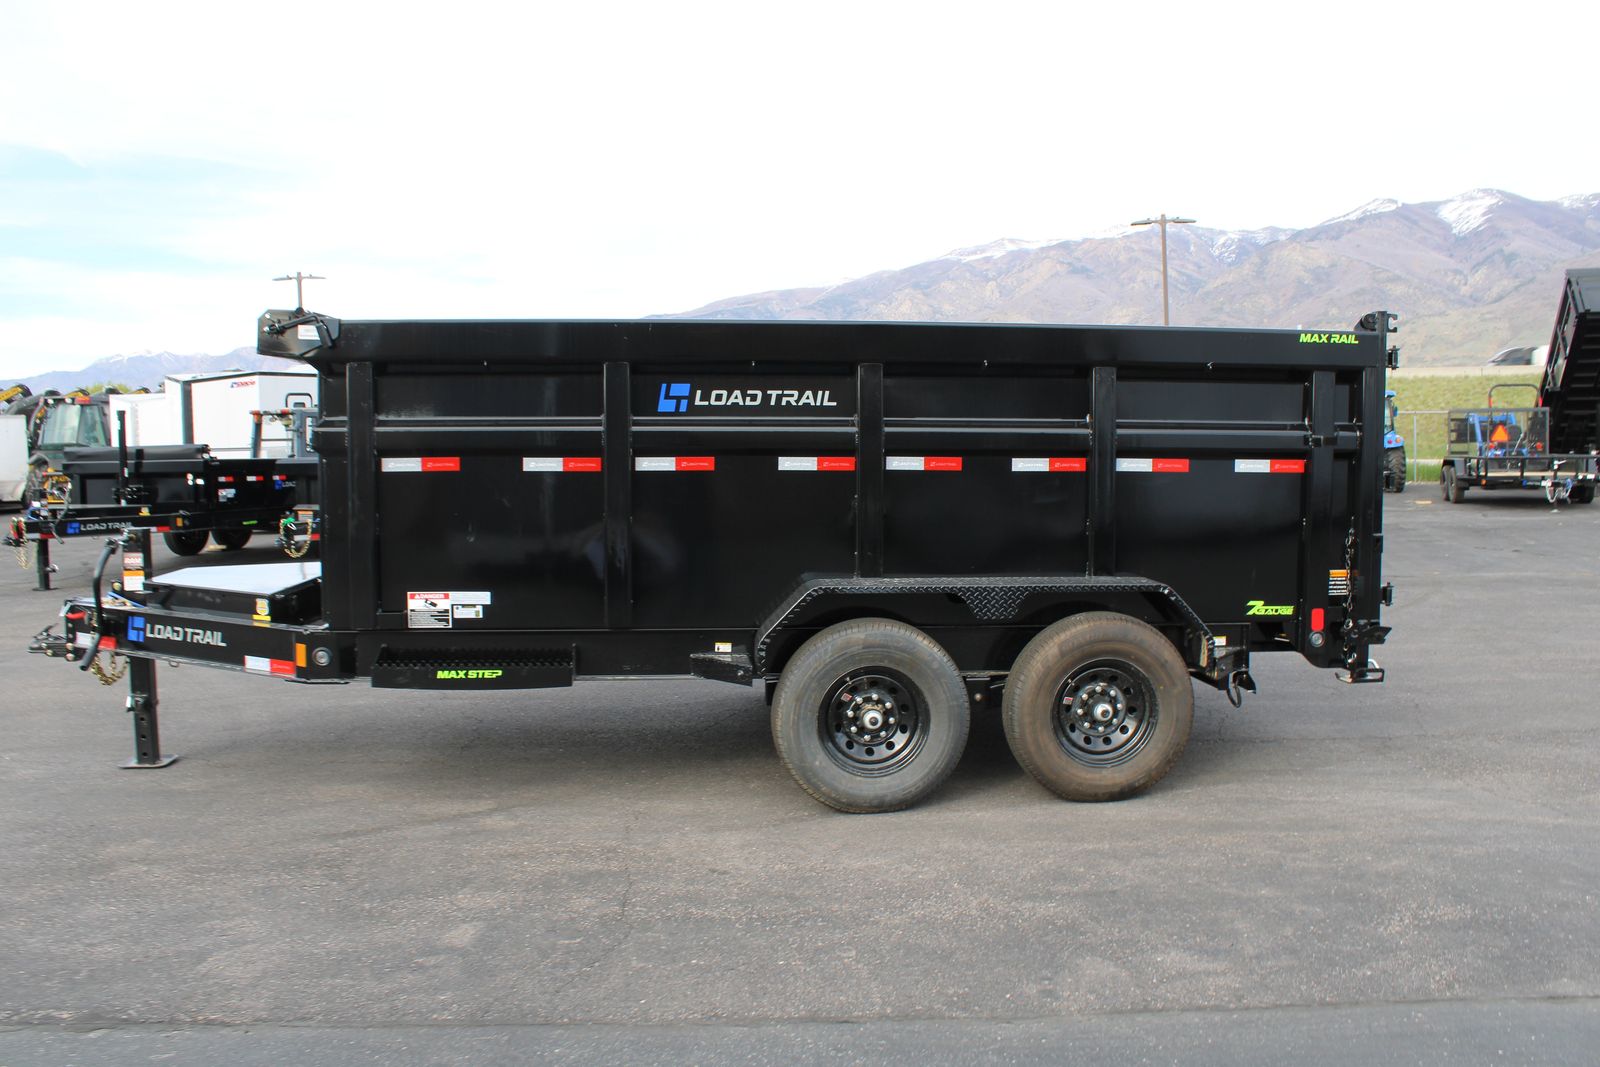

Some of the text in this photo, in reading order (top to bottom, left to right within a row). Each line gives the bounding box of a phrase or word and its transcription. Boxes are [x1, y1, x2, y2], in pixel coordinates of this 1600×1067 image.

[1300, 333, 1359, 344] MAX RAIL
[694, 390, 837, 406] LOAD TRAIL
[80, 523, 107, 531] LOAD
[145, 623, 227, 647] LOAD TRAIL
[436, 670, 503, 679] MAX STEP
